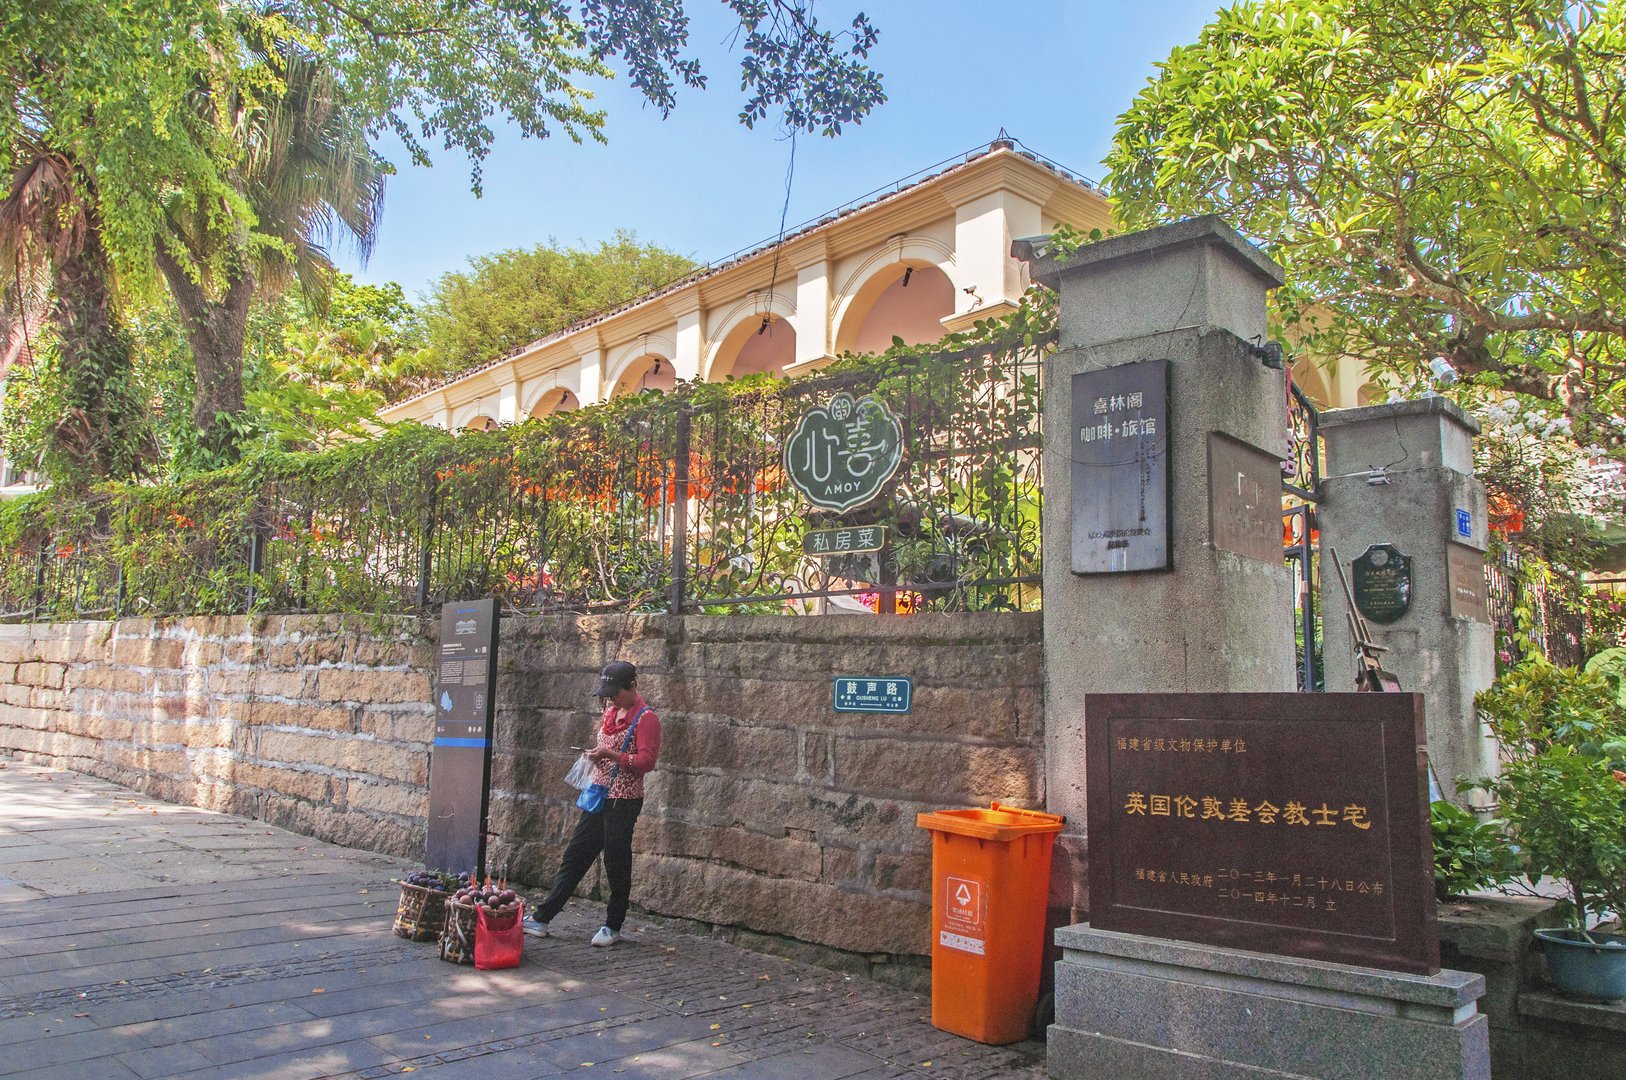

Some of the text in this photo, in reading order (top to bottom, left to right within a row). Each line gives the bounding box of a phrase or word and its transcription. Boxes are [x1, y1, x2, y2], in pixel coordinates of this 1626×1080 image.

[1092, 391, 1143, 415] 喜林阁
[824, 481, 861, 495] AMOY
[813, 528, 875, 551] 私房菜
[846, 681, 898, 695] 鼓声路
[1115, 737, 1247, 754] 福建省级文物保护单位
[1123, 791, 1372, 831] 英国伦敦差会教士宅
[1135, 868, 1214, 888] 福建省人民政府
